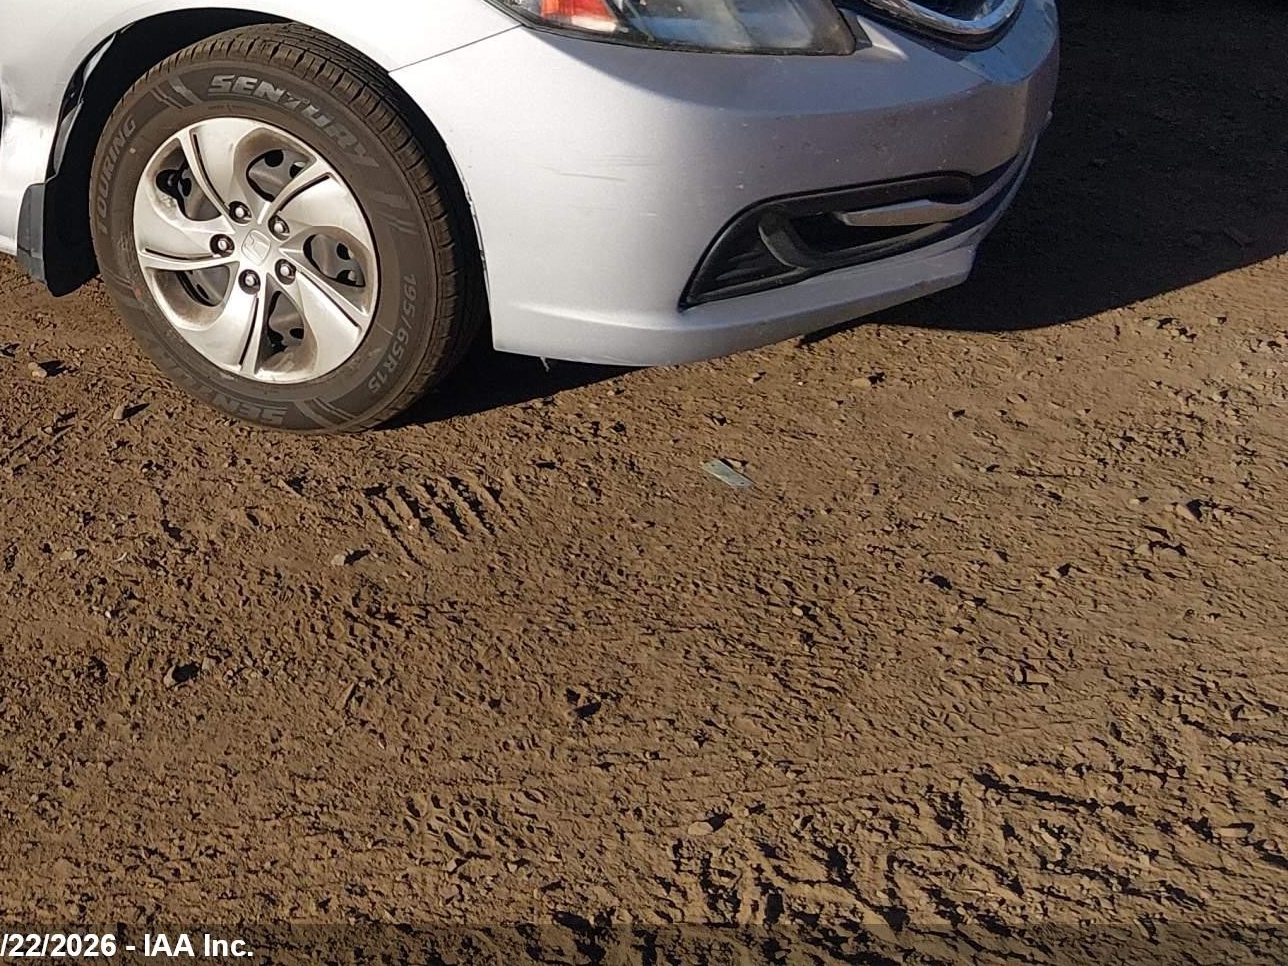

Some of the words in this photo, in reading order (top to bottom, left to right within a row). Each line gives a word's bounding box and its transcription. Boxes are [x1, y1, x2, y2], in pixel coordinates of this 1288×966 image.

[97, 114, 137, 235] TOURING
[208, 73, 380, 167] SENTURY
[367, 273, 418, 394] 195/65R15
